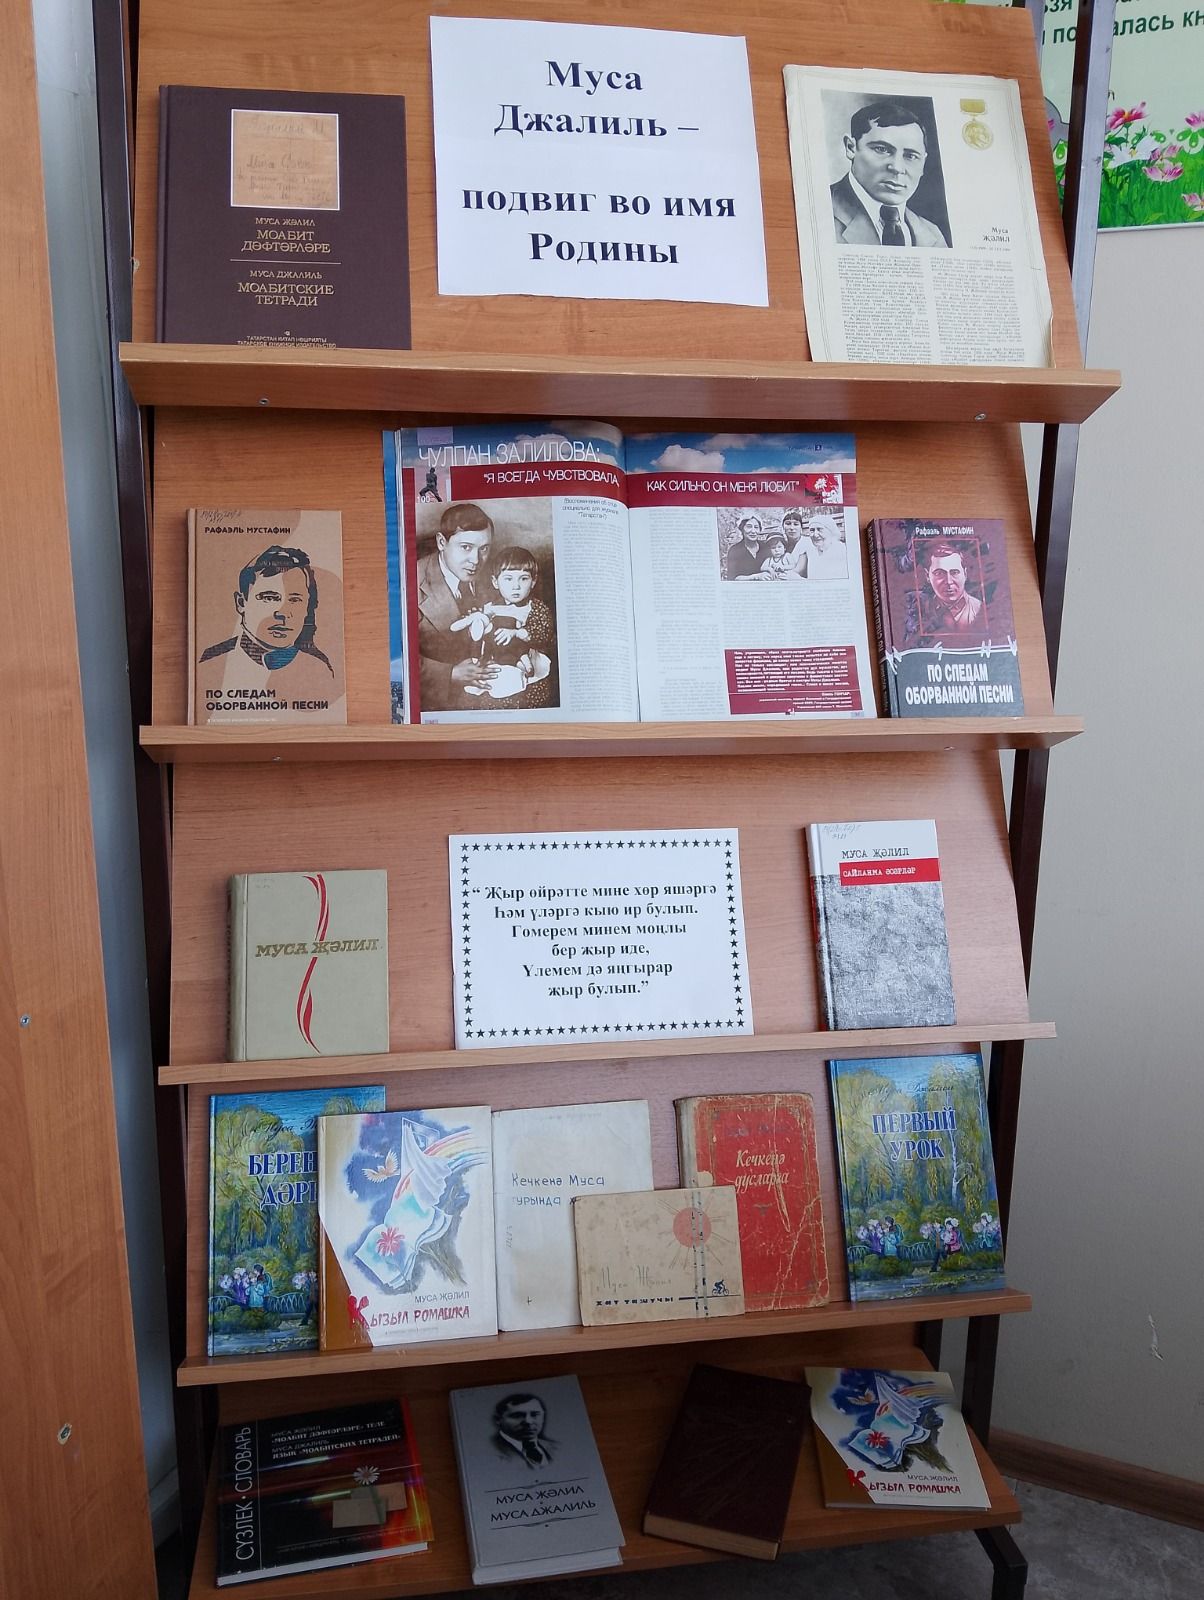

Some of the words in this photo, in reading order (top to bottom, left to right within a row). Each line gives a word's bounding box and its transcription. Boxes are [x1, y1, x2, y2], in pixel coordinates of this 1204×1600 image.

[545, 60, 643, 95] Муса
[494, 104, 667, 138] Джалиль
[462, 189, 597, 215] подвиг
[608, 194, 651, 215] во
[664, 197, 736, 217] имя
[255, 217, 280, 225] МУСА
[256, 229, 314, 241] МОАБИТ
[528, 232, 679, 264] Родины
[250, 270, 275, 278] МУСА
[276, 271, 322, 279] ДЖАЛИЛЬ
[238, 282, 334, 295] МОАБИТСКИЕ
[255, 295, 318, 307] ТЕТРАДИ
[418, 445, 491, 468] ЧУЛПАН
[496, 440, 600, 465] ЗАЛИЛОВА:
[497, 470, 541, 484] ВСЕГДА
[647, 480, 667, 492] КАК
[669, 480, 711, 493] СИЛЬНО
[712, 481, 728, 492] ОН
[729, 480, 757, 493] МЕНЯ
[204, 526, 244, 534] РАФАЭЛЬ
[246, 527, 291, 535] МУСТАФИН
[915, 526, 940, 536] Рафаэль
[942, 526, 974, 535] МУСТАФИН
[927, 665, 942, 683] ПО
[944, 663, 988, 684] СЛЕДАМ
[206, 690, 223, 699] ПО
[227, 689, 276, 700] СЛЕДАМ
[905, 682, 978, 705] ОБОРВАННОЙ
[979, 685, 1013, 703] ПЕСНИ
[206, 699, 288, 711] ОБОРВАННОЙ
[292, 701, 328, 710] ПЕСНИ
[842, 849, 868, 859] МУСА
[872, 847, 909, 859] ҖӘЛИЛ
[485, 886, 524, 902] Җыр
[592, 886, 630, 897] мине
[663, 885, 717, 898] яшәргә
[494, 906, 525, 919] Һәм
[530, 907, 580, 921] үләргә
[584, 905, 619, 916] кыю
[624, 905, 642, 918] ир
[646, 902, 698, 918] булып.
[511, 925, 578, 941] Гомерем
[582, 925, 631, 936] минем
[636, 924, 687, 936] моңлы
[255, 943, 309, 958] МУСА
[552, 943, 577, 960] бер
[620, 944, 650, 956] иде,
[522, 964, 582, 977] Үлемем
[586, 965, 603, 977] дә
[607, 962, 673, 977] яңгырар
[872, 1107, 957, 1135] ПЕРВЫЙ
[889, 1138, 945, 1162] УРОК
[736, 1150, 786, 1168] Кечкенә
[512, 1173, 562, 1188] Кечкенә
[568, 1173, 605, 1188] Муса
[414, 1293, 437, 1303] МУСА
[414, 1305, 470, 1323] РОМАШКА
[234, 1427, 252, 1493] СЛОВАРЬ
[908, 1483, 961, 1494] РОМАШКА
[496, 1493, 533, 1504] МУСА
[490, 1509, 529, 1522] МУСА
[531, 1500, 596, 1517] ДЖАЛИЛЬ
